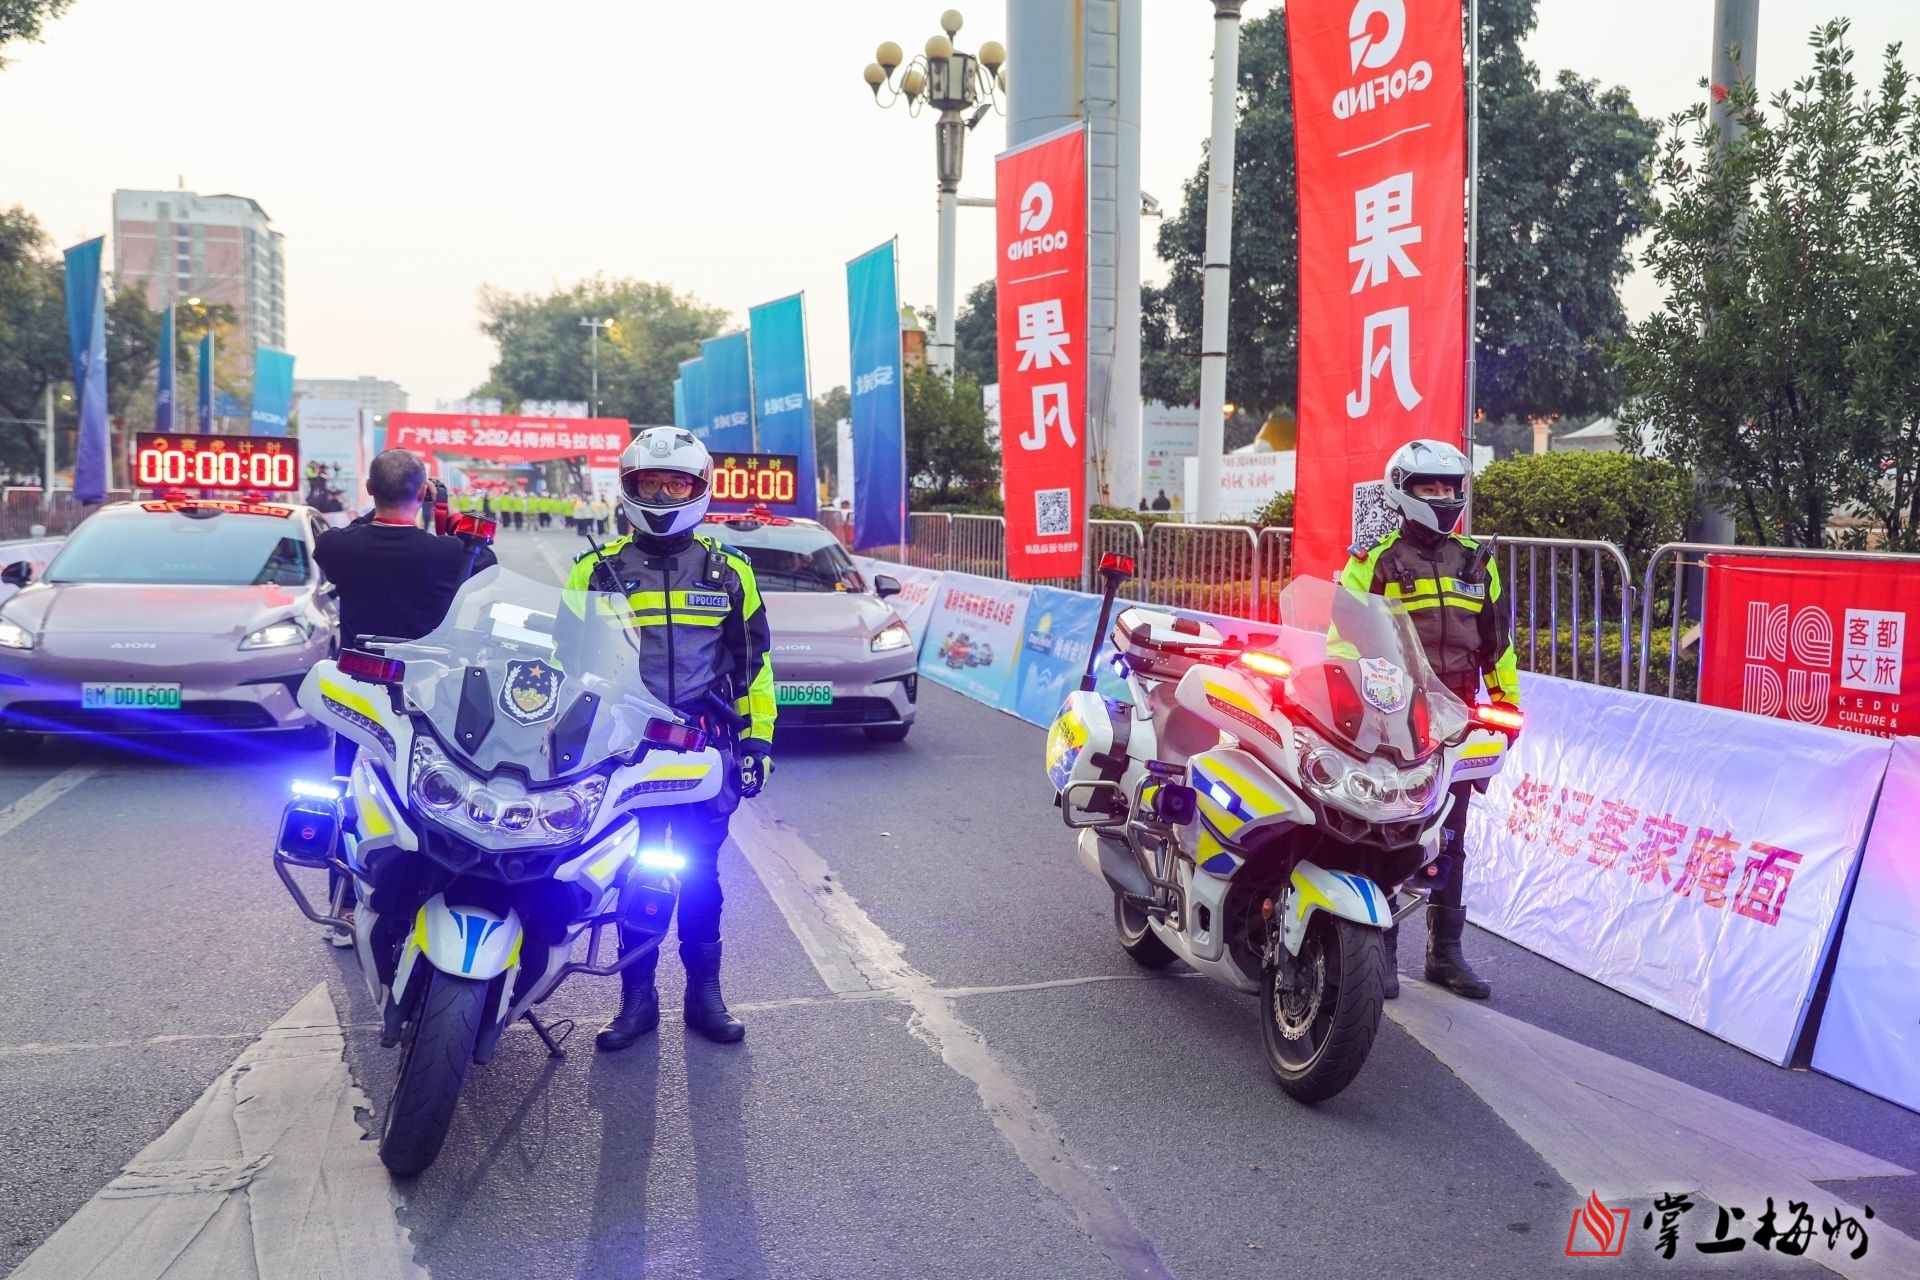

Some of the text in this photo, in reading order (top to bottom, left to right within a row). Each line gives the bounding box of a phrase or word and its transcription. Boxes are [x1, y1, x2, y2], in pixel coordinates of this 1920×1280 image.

[140, 449, 294, 487] 00:00:00
[1848, 617, 1898, 649] 客都
[1846, 653, 1897, 685] 文旅
[780, 685, 831, 702] DD6968
[1839, 710, 1898, 728] CULTURE &
